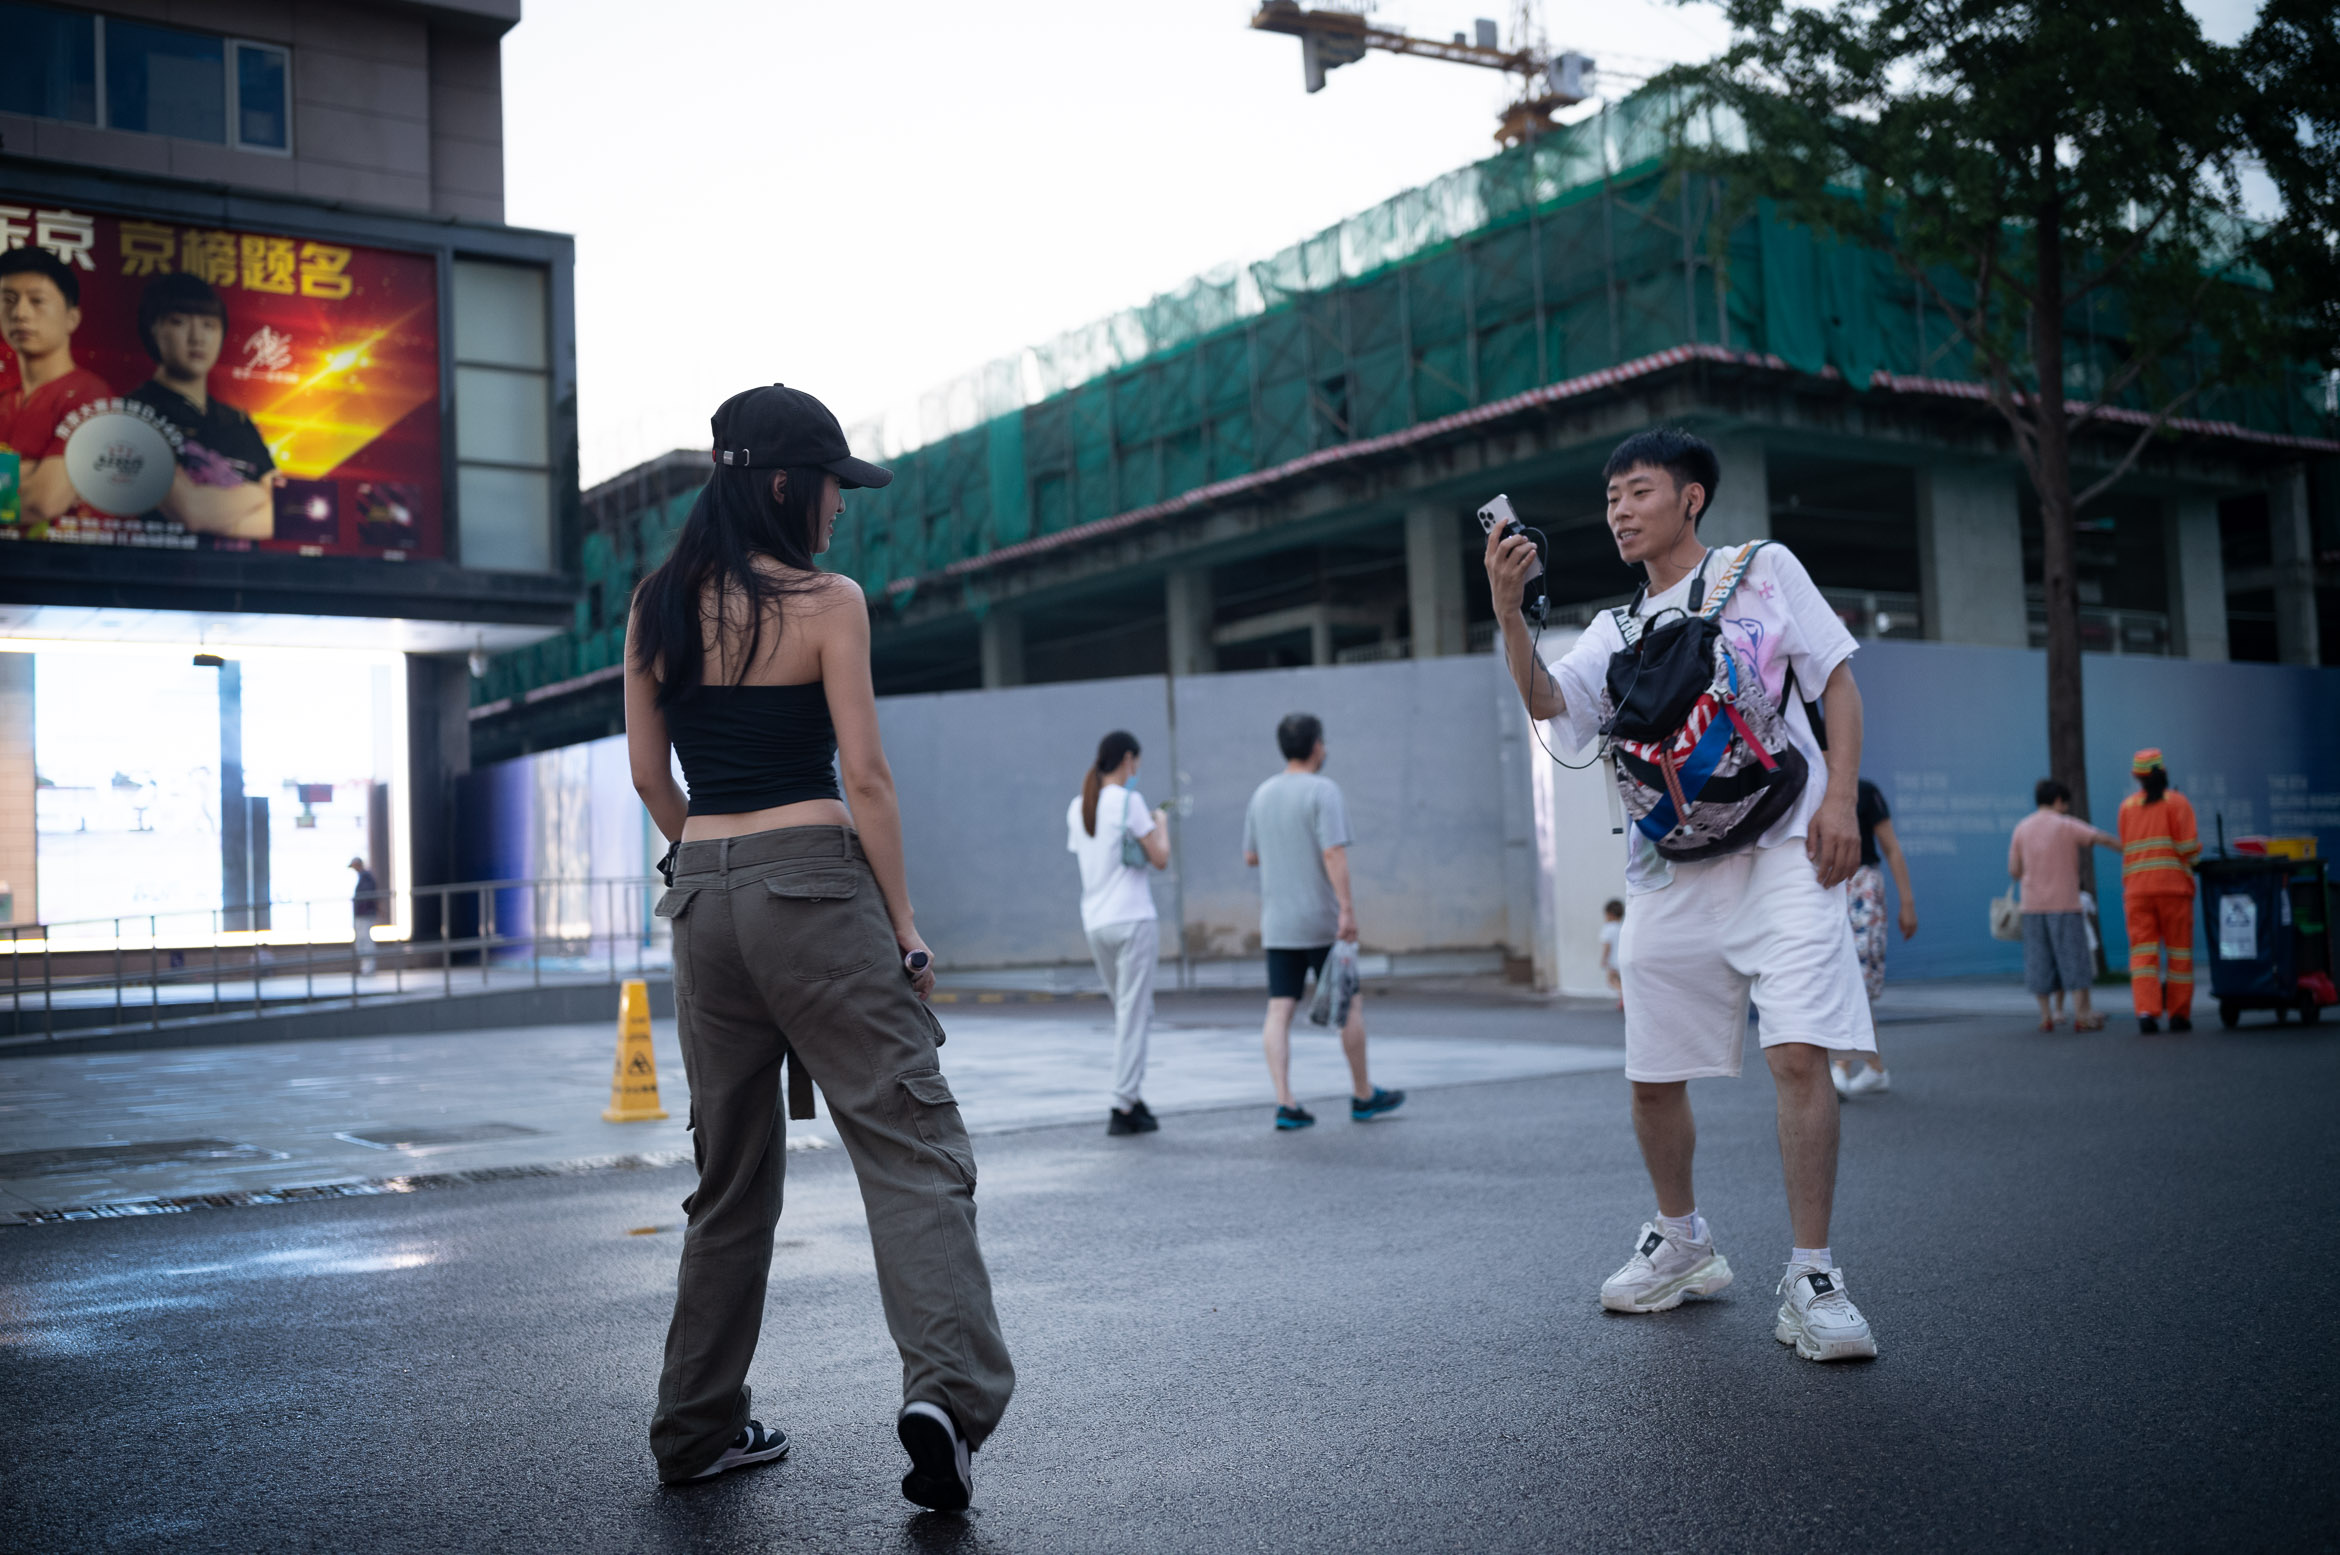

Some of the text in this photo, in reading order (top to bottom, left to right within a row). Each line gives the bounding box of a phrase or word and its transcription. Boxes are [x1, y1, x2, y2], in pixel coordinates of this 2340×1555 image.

[119, 221, 353, 300] 京榜题名
[1698, 556, 1750, 617] EVB&YL
